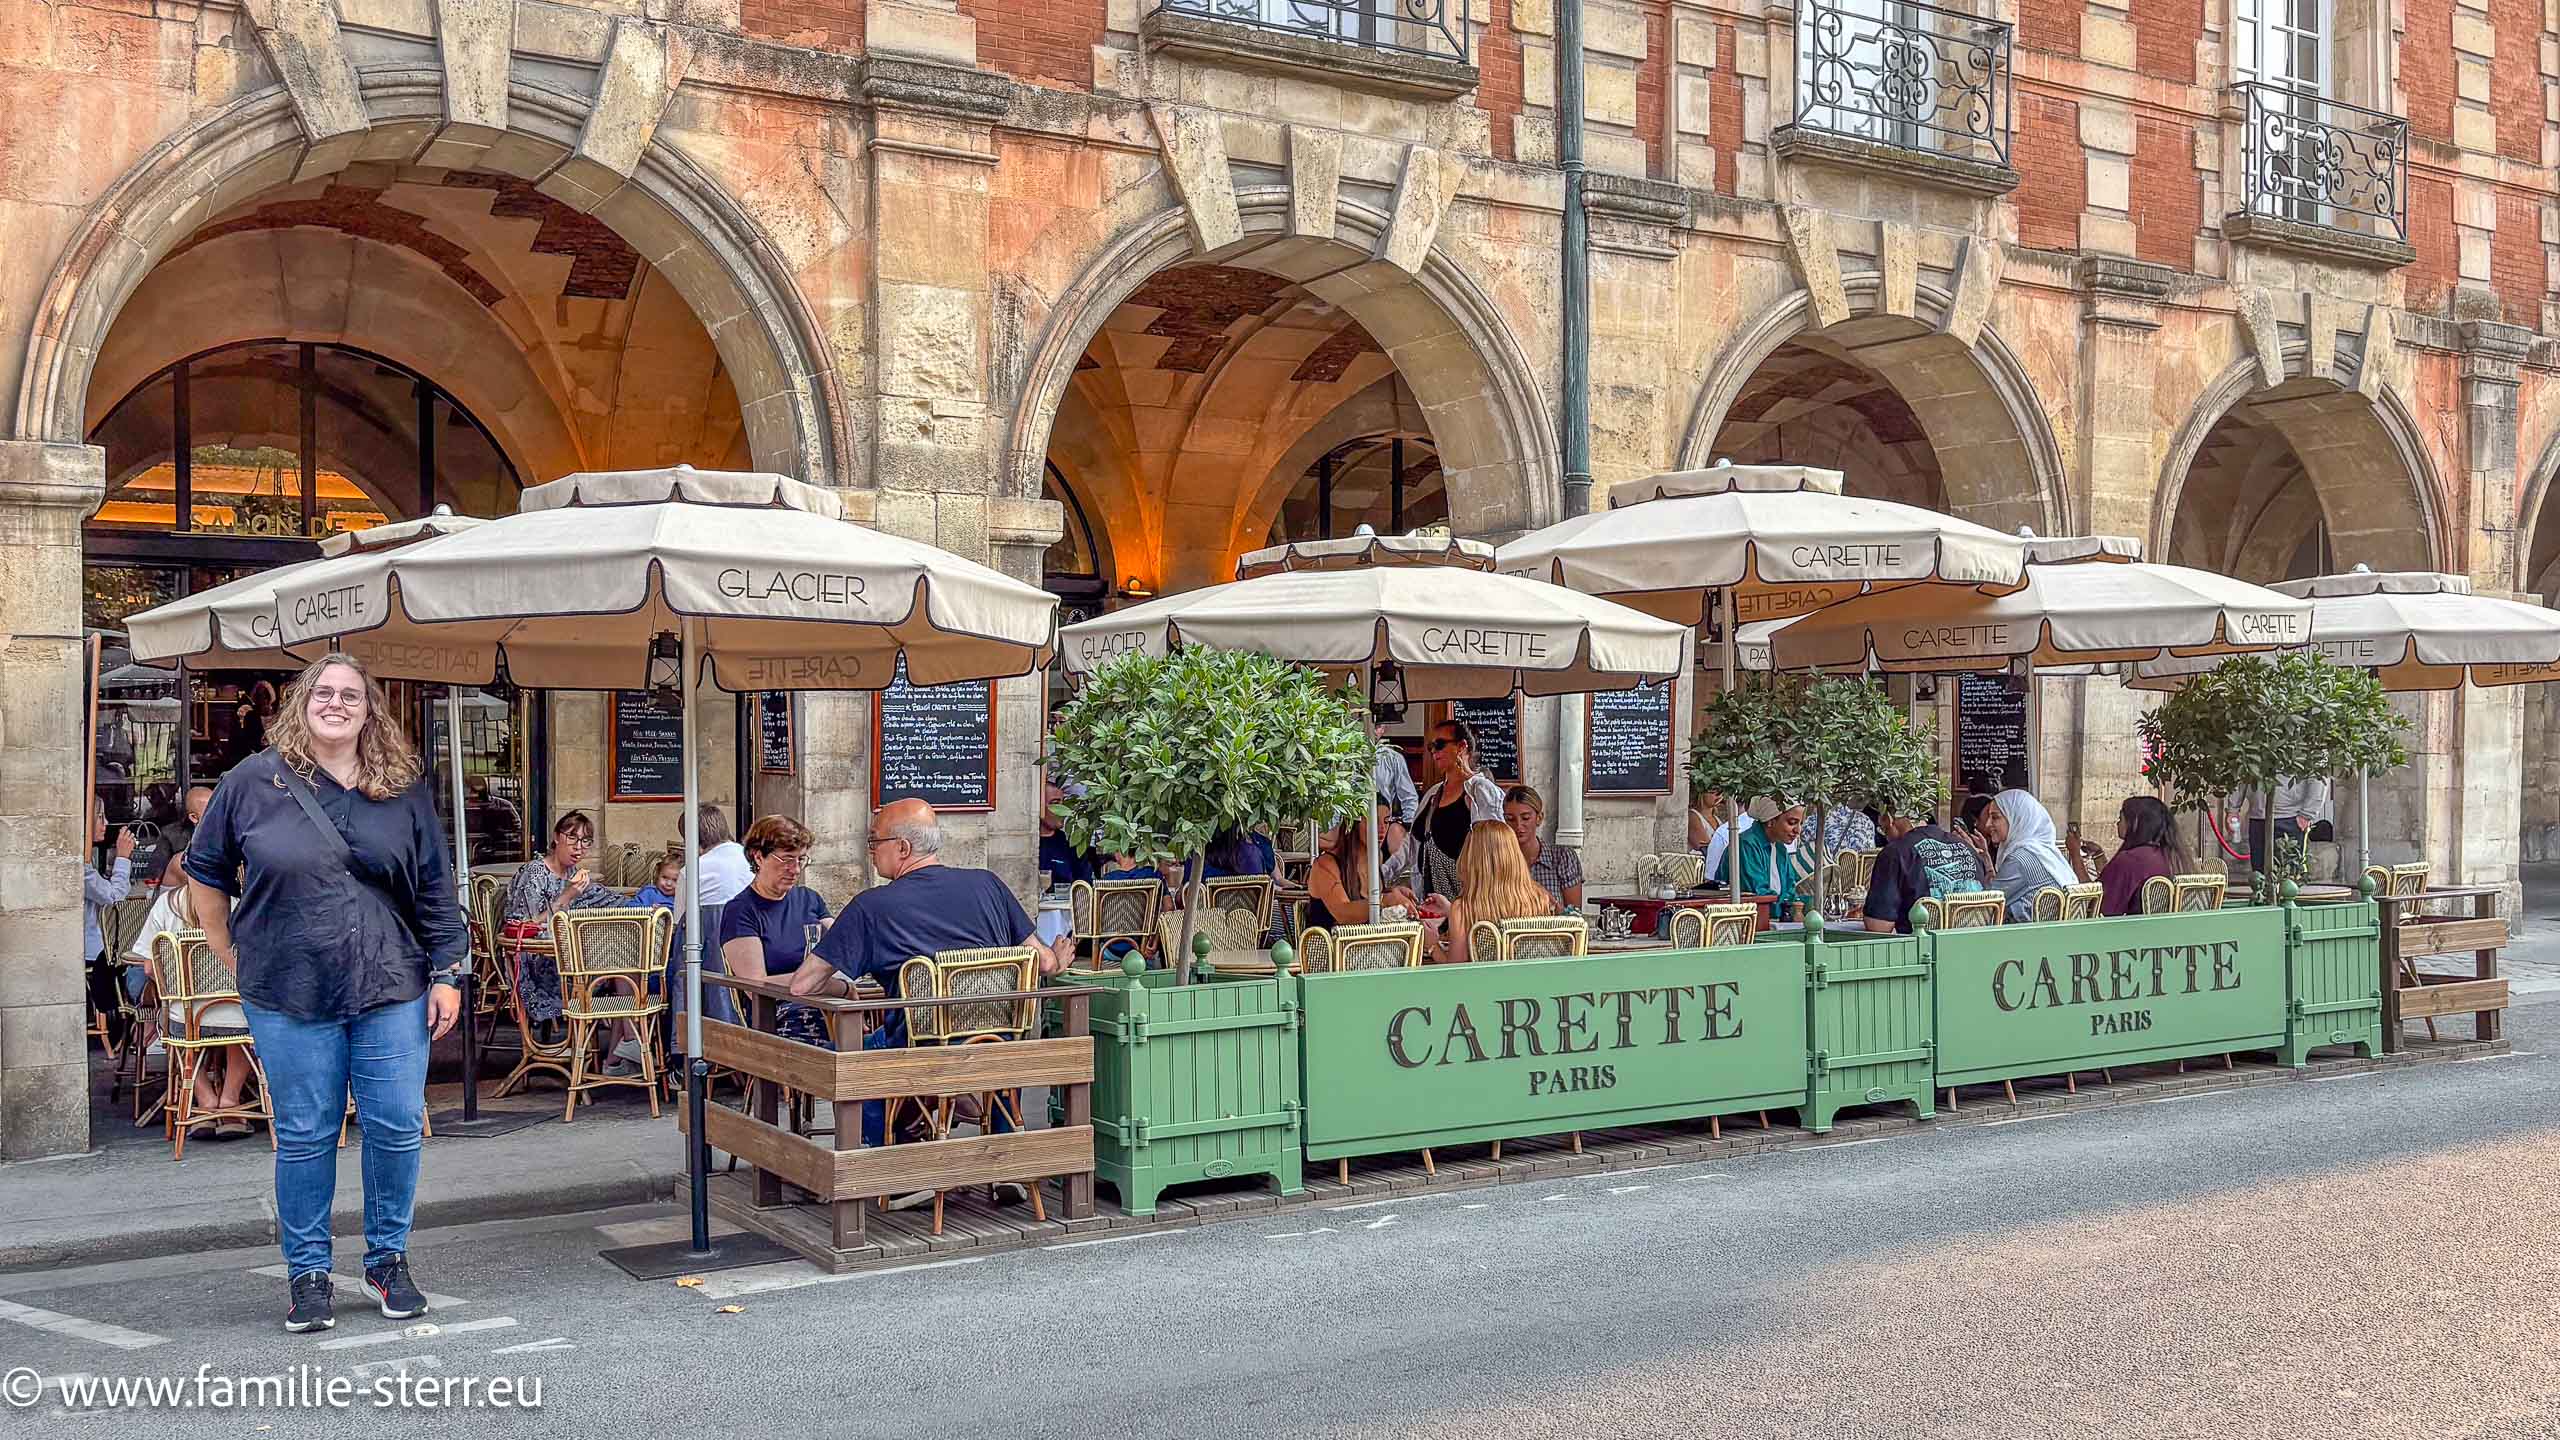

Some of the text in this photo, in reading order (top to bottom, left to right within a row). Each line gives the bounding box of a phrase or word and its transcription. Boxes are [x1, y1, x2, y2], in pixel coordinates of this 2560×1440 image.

[191, 513, 294, 536] SALON
[311, 516, 346, 537] DE
[1791, 544, 1902, 568] CARETTE
[718, 568, 868, 605] GLACIER
[295, 584, 365, 626] CARETTE
[1903, 624, 2009, 650] CARETTE
[2242, 614, 2297, 634] CARETTE
[1081, 631, 1147, 660] GLACIER
[1422, 627, 1547, 658] CARETTE
[1992, 940, 2241, 1012] CARETTE
[1386, 981, 1743, 1069] CARETTE
[2090, 1009, 2153, 1036] PARIS
[1528, 1064, 1618, 1096] PARIS
